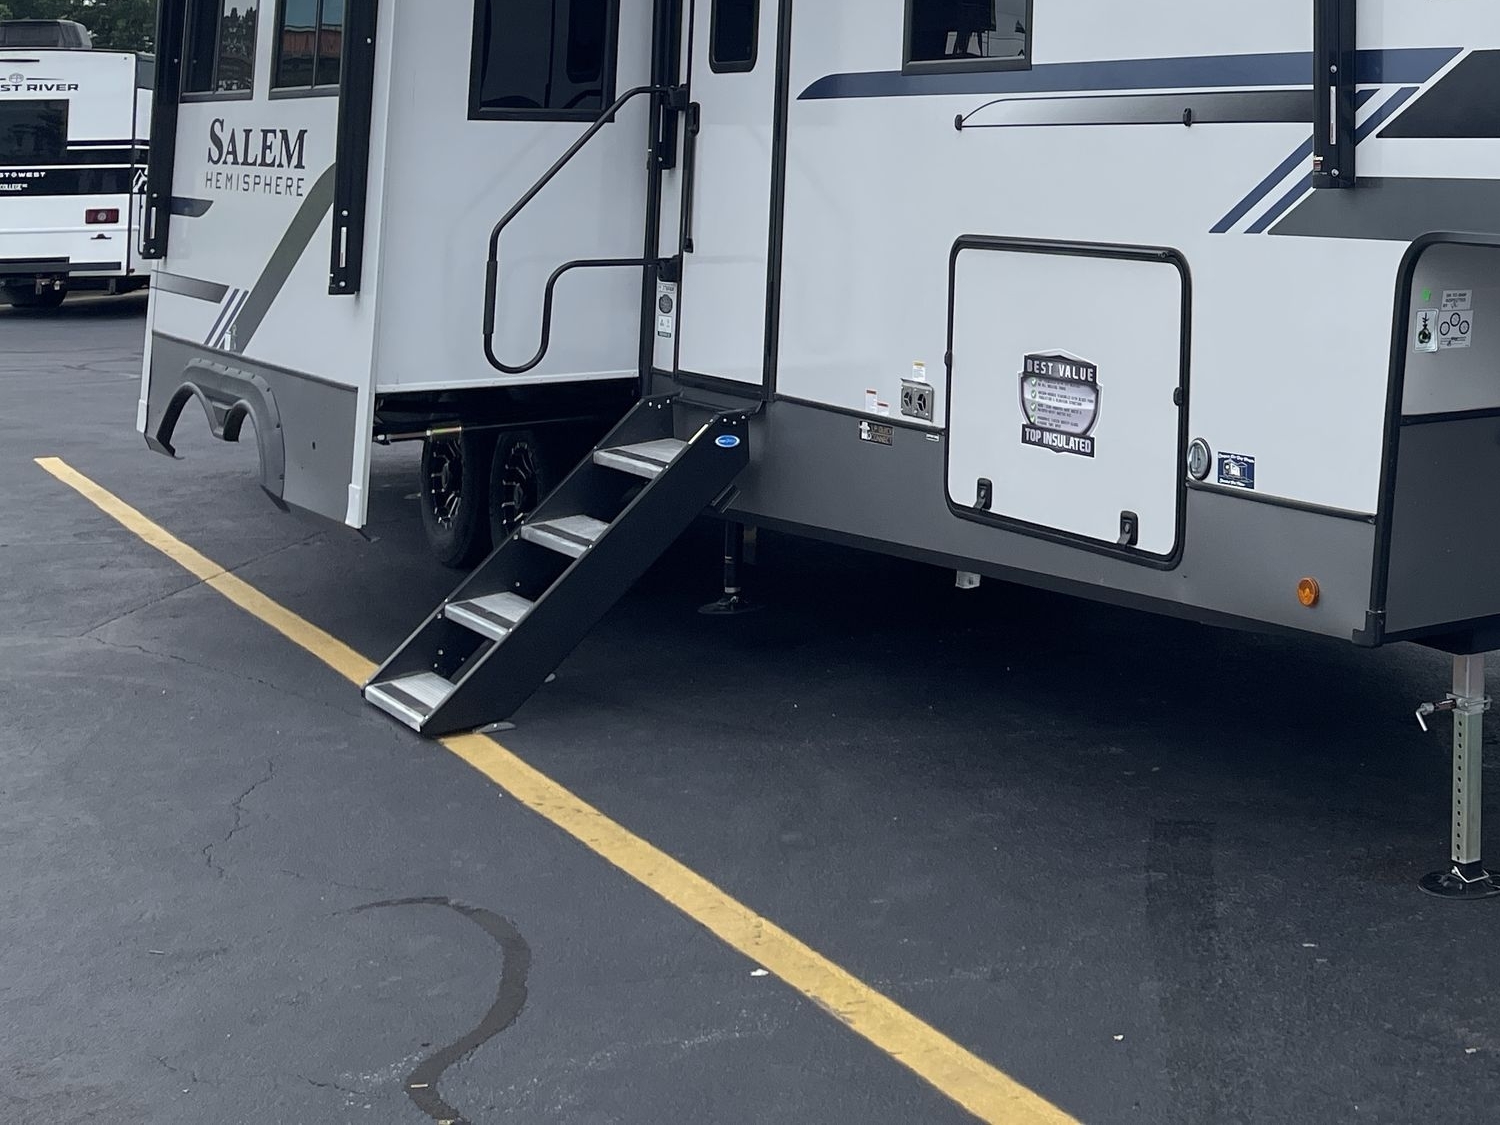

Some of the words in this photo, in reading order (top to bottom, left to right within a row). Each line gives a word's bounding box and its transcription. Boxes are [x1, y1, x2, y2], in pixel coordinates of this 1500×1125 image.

[26, 83, 79, 92] RIVER
[207, 117, 308, 170] SALEM
[205, 171, 305, 197] HEMISPHERE
[1026, 359, 1054, 375] BEST
[1059, 364, 1094, 382] VALUE
[1025, 428, 1042, 443] TOP
[1043, 431, 1092, 453] INSULATED
